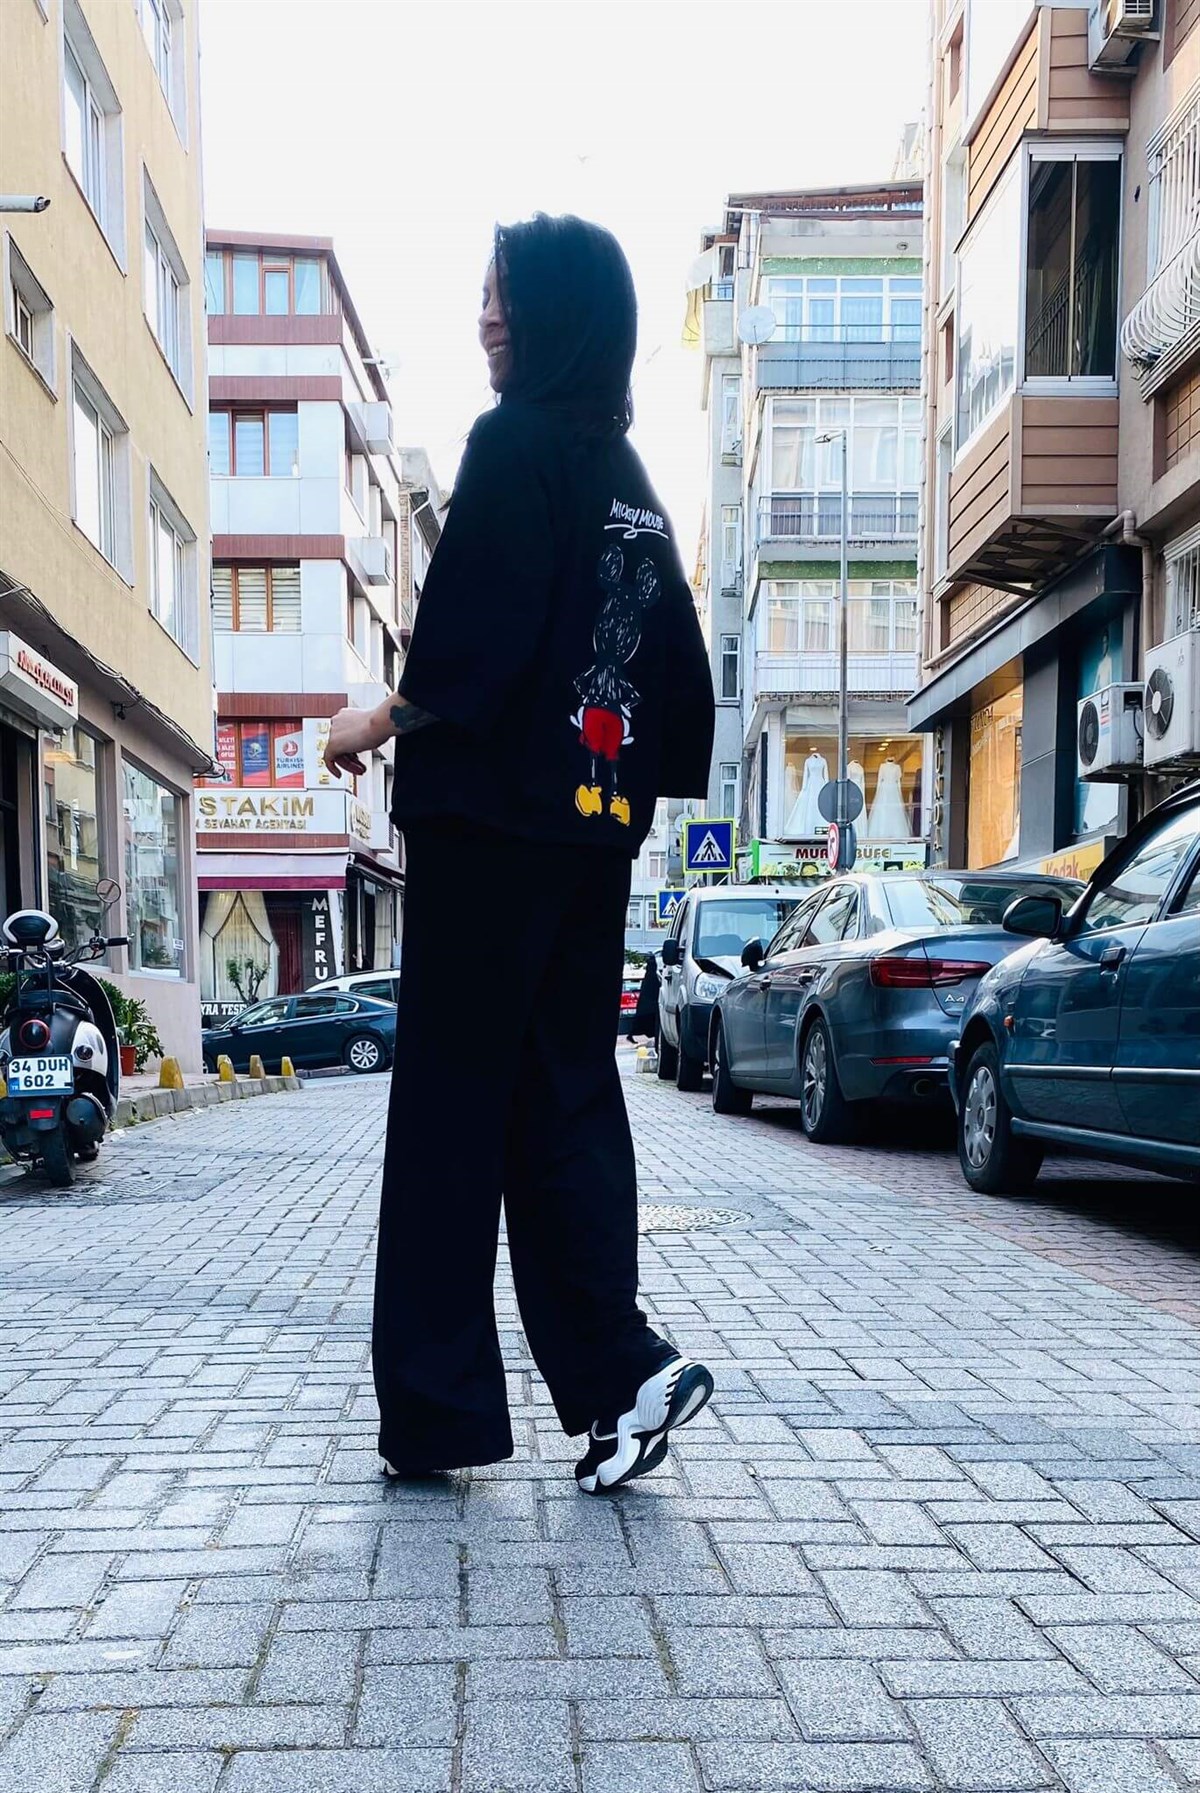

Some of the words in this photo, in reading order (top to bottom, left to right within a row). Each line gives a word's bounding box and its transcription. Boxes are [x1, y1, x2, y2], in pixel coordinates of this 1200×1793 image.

[609, 498, 640, 528] MICKEY
[944, 993, 965, 1003] A4
[11, 1060, 31, 1073] 34
[37, 1059, 68, 1072] DUH
[23, 1074, 55, 1088] 602
